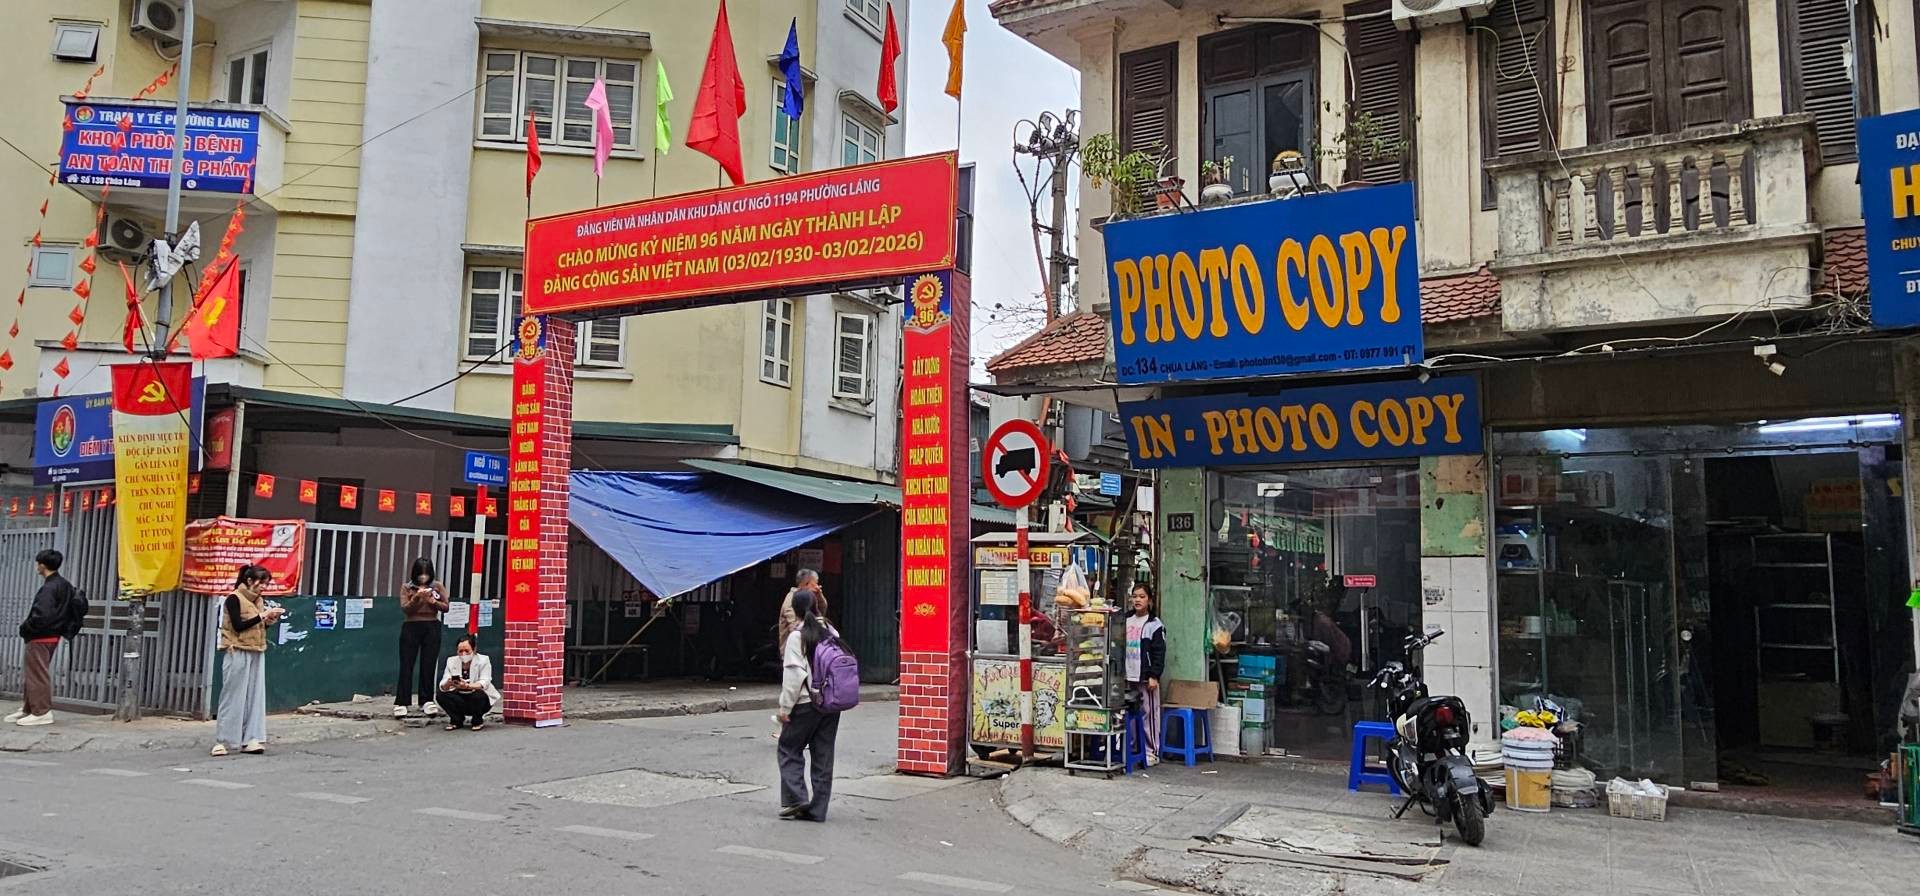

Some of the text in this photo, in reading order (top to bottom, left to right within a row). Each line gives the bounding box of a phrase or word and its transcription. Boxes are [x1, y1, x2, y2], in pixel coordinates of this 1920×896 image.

[137, 113, 145, 123] Y
[147, 111, 163, 124] TẾ
[217, 115, 250, 130] LÁNG
[195, 134, 242, 155] BỆNH
[66, 153, 94, 170] AN
[148, 157, 194, 176] THC
[197, 156, 249, 177] PHẨM
[577, 178, 880, 237] ĐẢNG VIÊN VÀ NHÂN DÂN KHU DÂN CƯ NGÕ 1194 PHƯỜNG LÁNG
[558, 204, 902, 269] CHÀO MỪNG KỶ NIỆM 96 NĂM NGÀY THÀNH LẬP
[543, 273, 580, 294] ĐẢNG
[582, 268, 619, 292] CỘNG
[622, 263, 650, 284] SẢN
[652, 259, 683, 283] VIỆT
[685, 256, 719, 276] NAM
[1113, 225, 1407, 345] PHOTO COPY
[920, 309, 934, 323] 96
[525, 344, 535, 356] 96
[1135, 357, 1158, 375] 134
[1360, 347, 1381, 359] 0977
[912, 356, 940, 378] XÂY DỰNG
[926, 384, 943, 407] THIỆN
[516, 421, 538, 436] VIỆT NAM
[912, 413, 940, 435] NHÀ NƯỚC
[1130, 413, 1176, 459] IN
[1201, 402, 1339, 456] PHOTO
[1350, 393, 1465, 447] COPY
[909, 441, 943, 466] PHÁP QUYỀN
[905, 474, 948, 498] XHCN VIỆT NAM
[905, 503, 916, 525] CỦA
[917, 504, 933, 525] NHÂN
[1171, 515, 1191, 530] 136
[134, 540, 145, 553] HỒ
[146, 541, 160, 552] CHÍ
[906, 539, 915, 555] DO
[915, 535, 931, 555] NHÂN
[512, 556, 533, 572] VIỆT NAM
[907, 565, 913, 586] VÌ
[914, 565, 930, 586] NHÂN
[930, 565, 942, 586] DÂN
[993, 718, 1020, 729] Super
